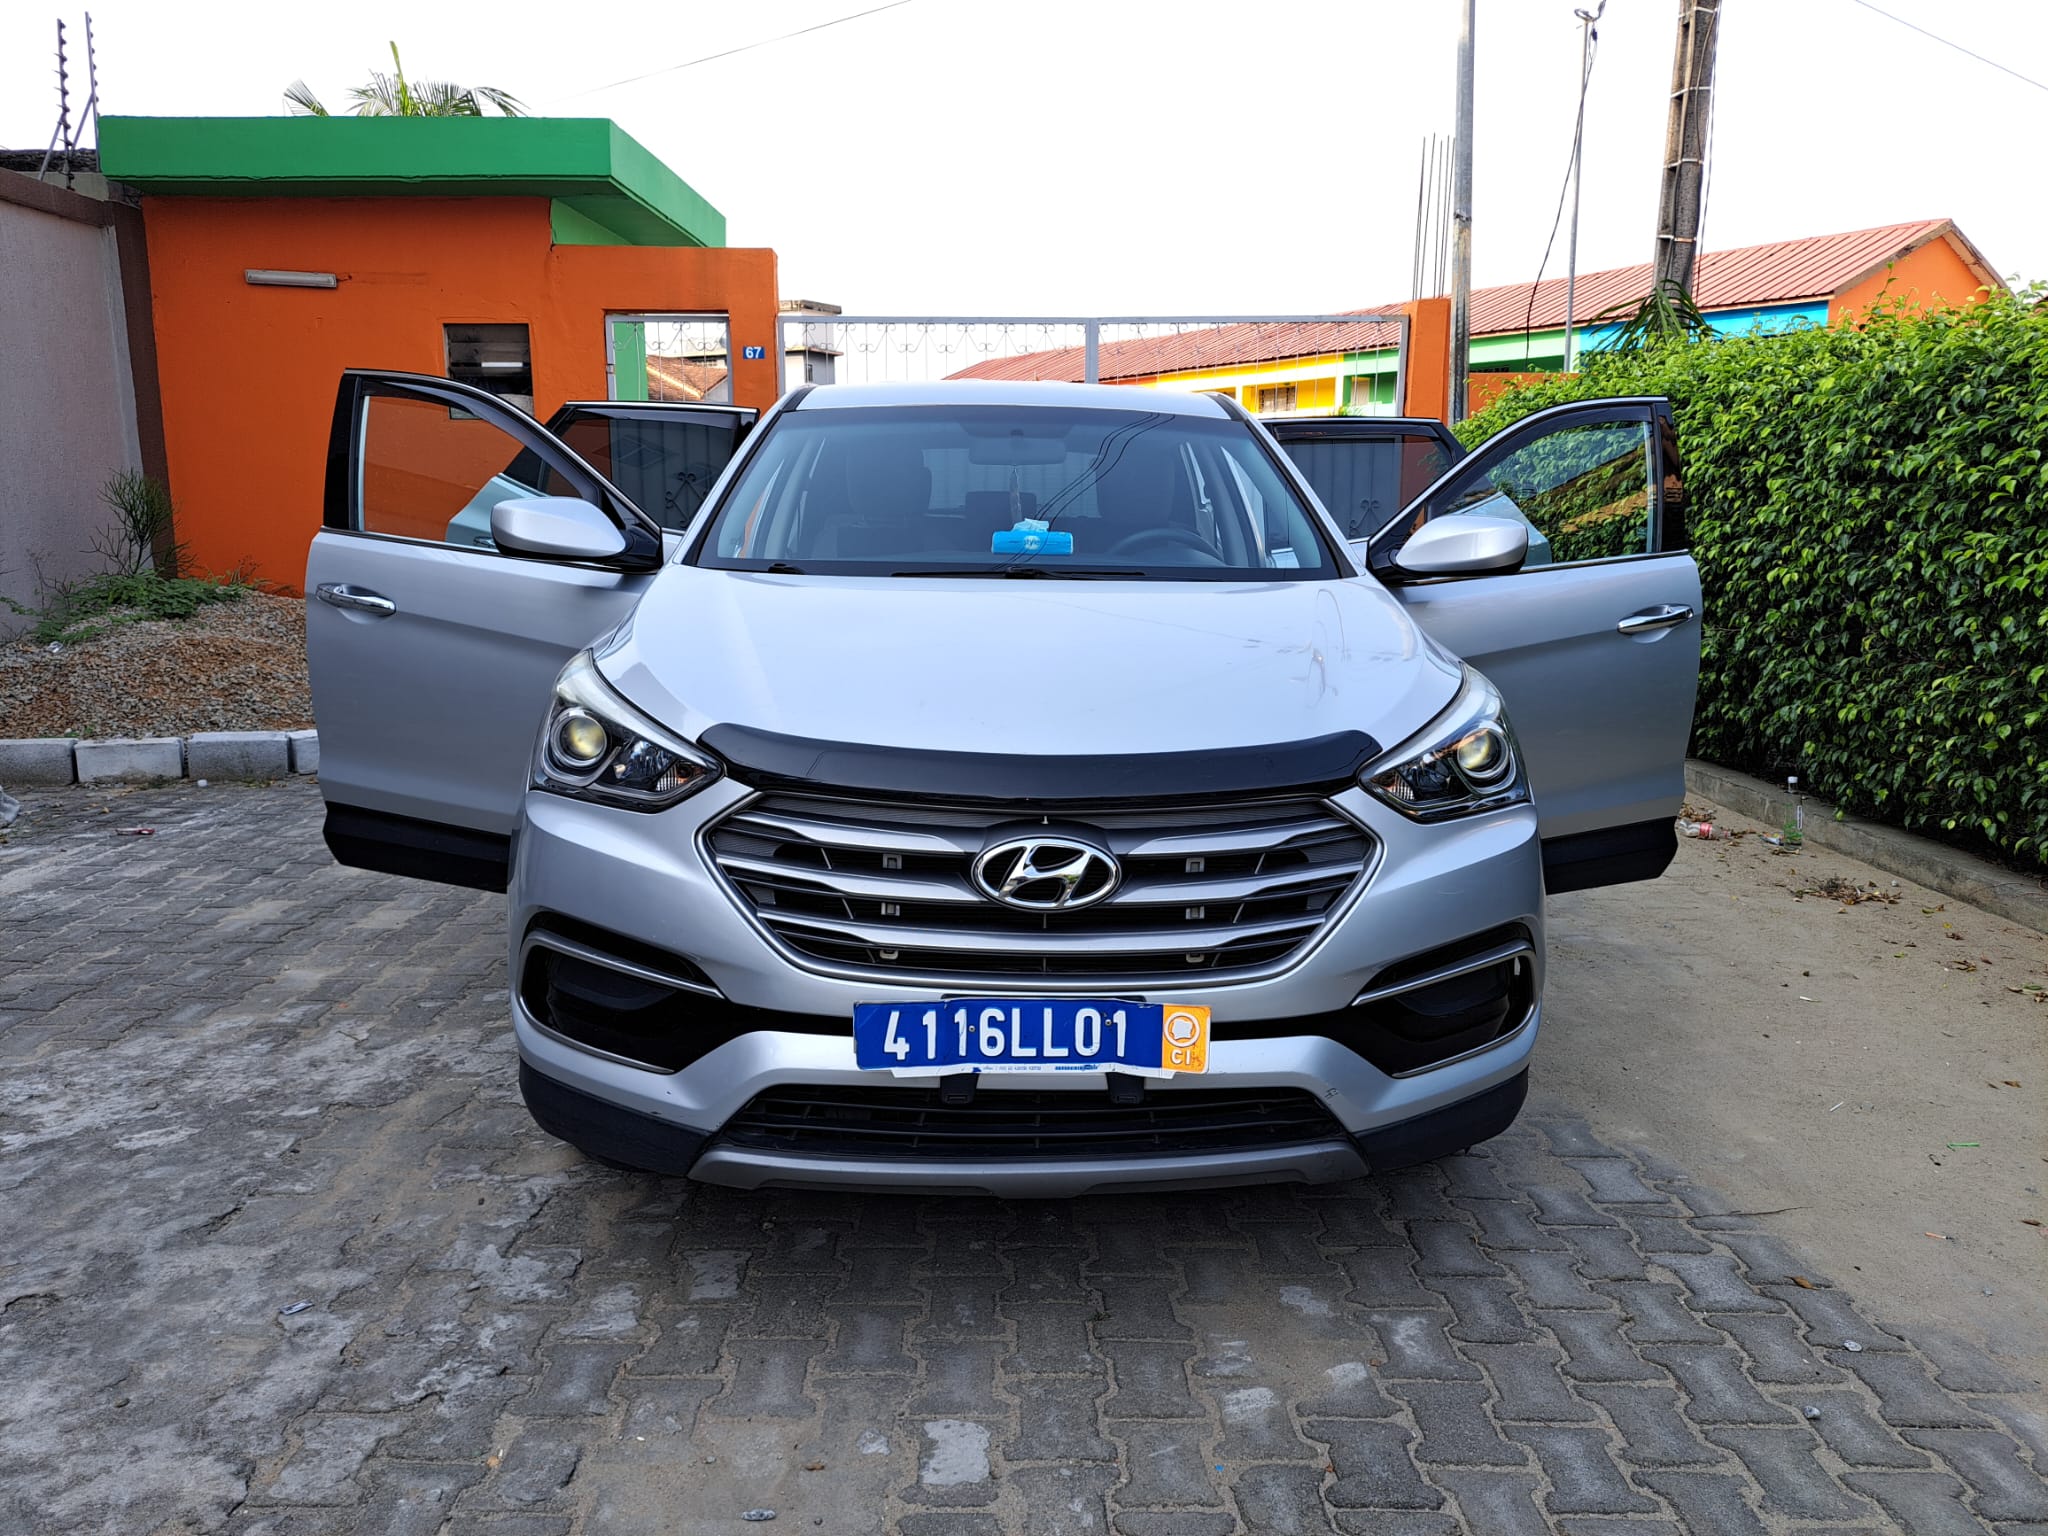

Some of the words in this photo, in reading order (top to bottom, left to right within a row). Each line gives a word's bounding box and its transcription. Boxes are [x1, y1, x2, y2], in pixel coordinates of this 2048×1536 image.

[745, 346, 762, 359] 67
[883, 1007, 1127, 1061] 4116LL01
[1171, 1049, 1192, 1066] CI
